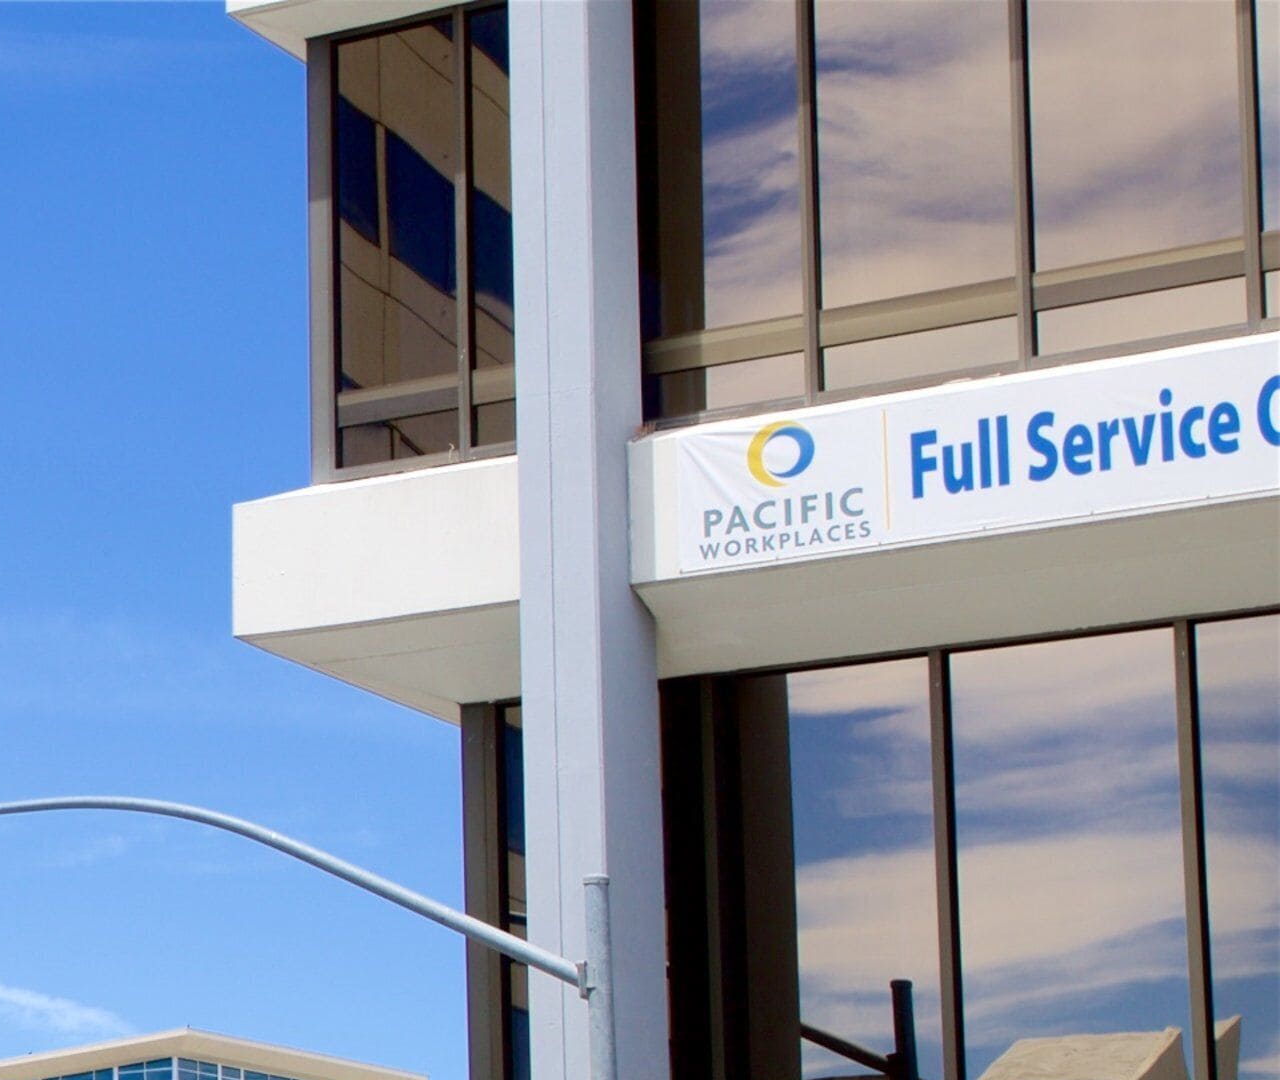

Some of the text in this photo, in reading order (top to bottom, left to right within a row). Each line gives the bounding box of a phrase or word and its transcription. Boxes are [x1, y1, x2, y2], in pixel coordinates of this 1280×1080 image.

[910, 414, 1010, 499] Full
[1026, 387, 1241, 483] Service
[703, 487, 865, 538] PACIFIC
[699, 520, 872, 561] WORKPLACES
